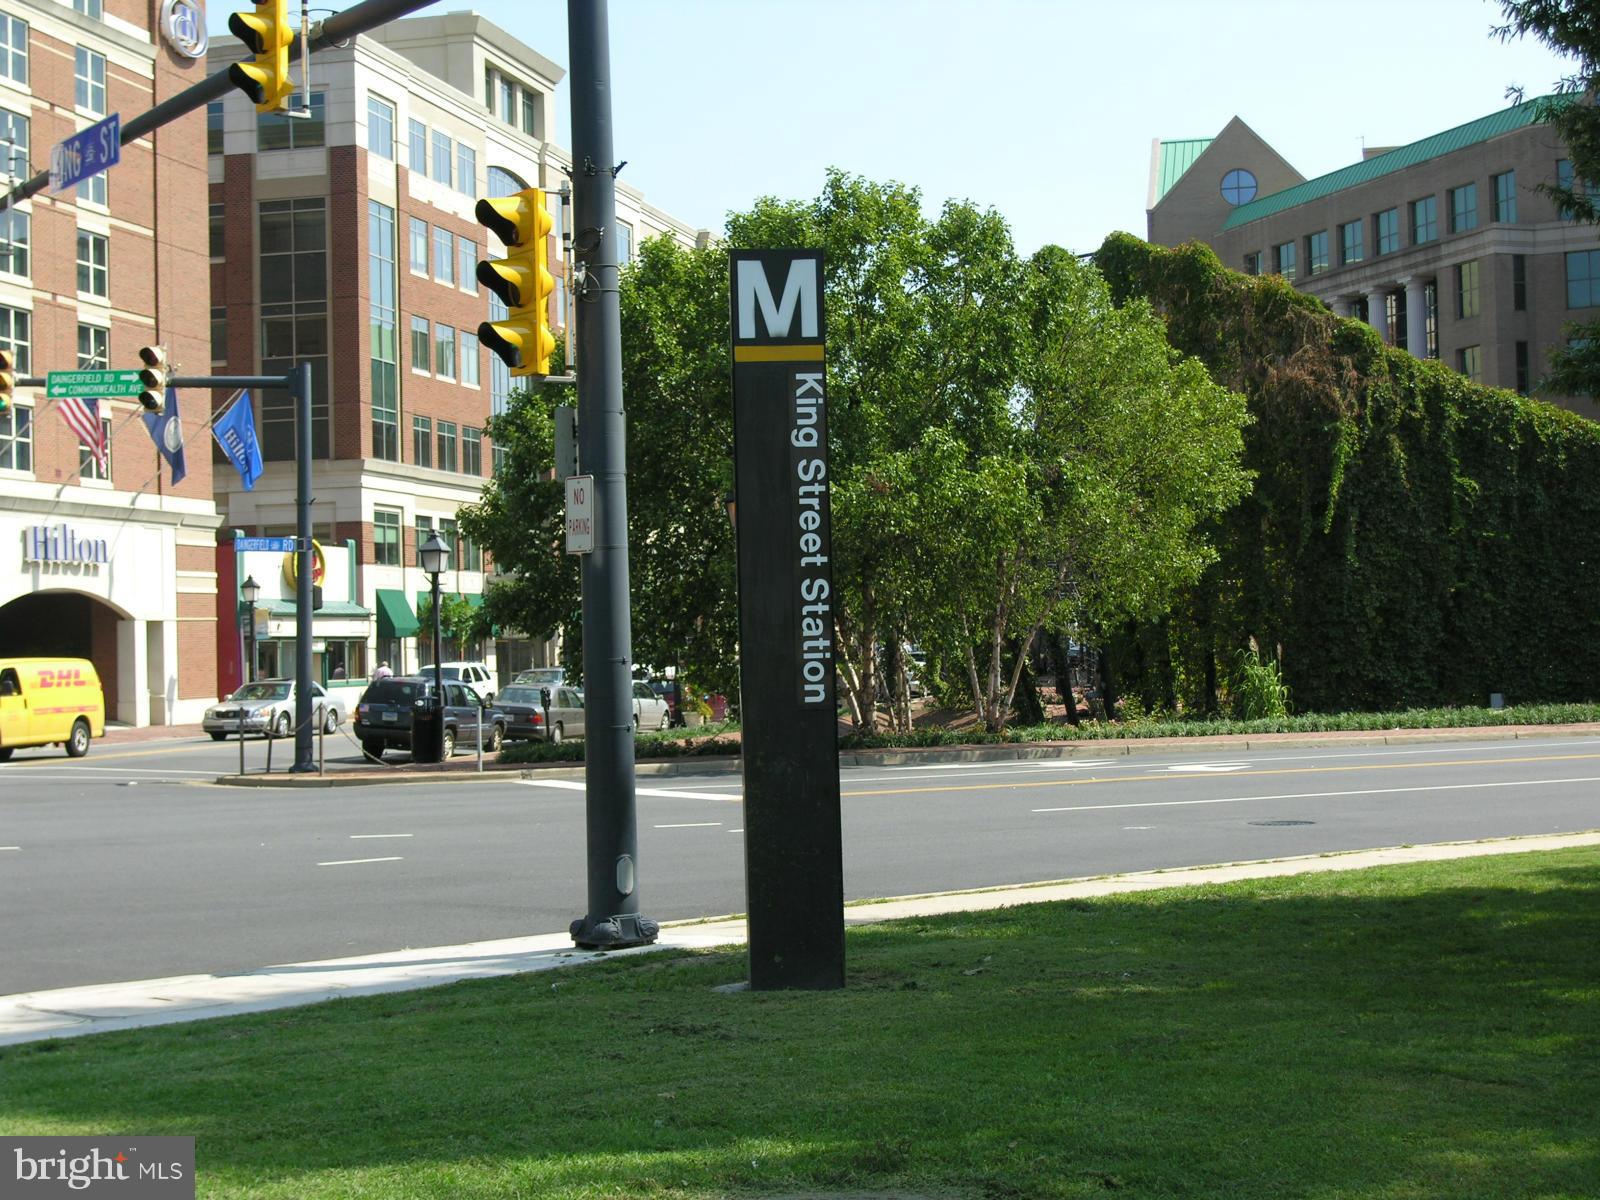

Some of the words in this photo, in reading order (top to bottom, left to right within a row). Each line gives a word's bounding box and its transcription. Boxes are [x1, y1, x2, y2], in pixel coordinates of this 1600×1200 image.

[100, 121, 116, 163] ST
[737, 259, 818, 338] M
[68, 384, 126, 394] COMMONWEALTH
[128, 384, 142, 393] AVE
[103, 373, 115, 383] RD
[791, 373, 824, 448] King
[574, 488, 584, 504] NO
[569, 518, 592, 536] PARKING
[798, 458, 828, 567] Street
[28, 523, 107, 563] Hilton
[282, 539, 294, 551] RD
[801, 578, 830, 703] Station
[38, 669, 86, 688] DHL
